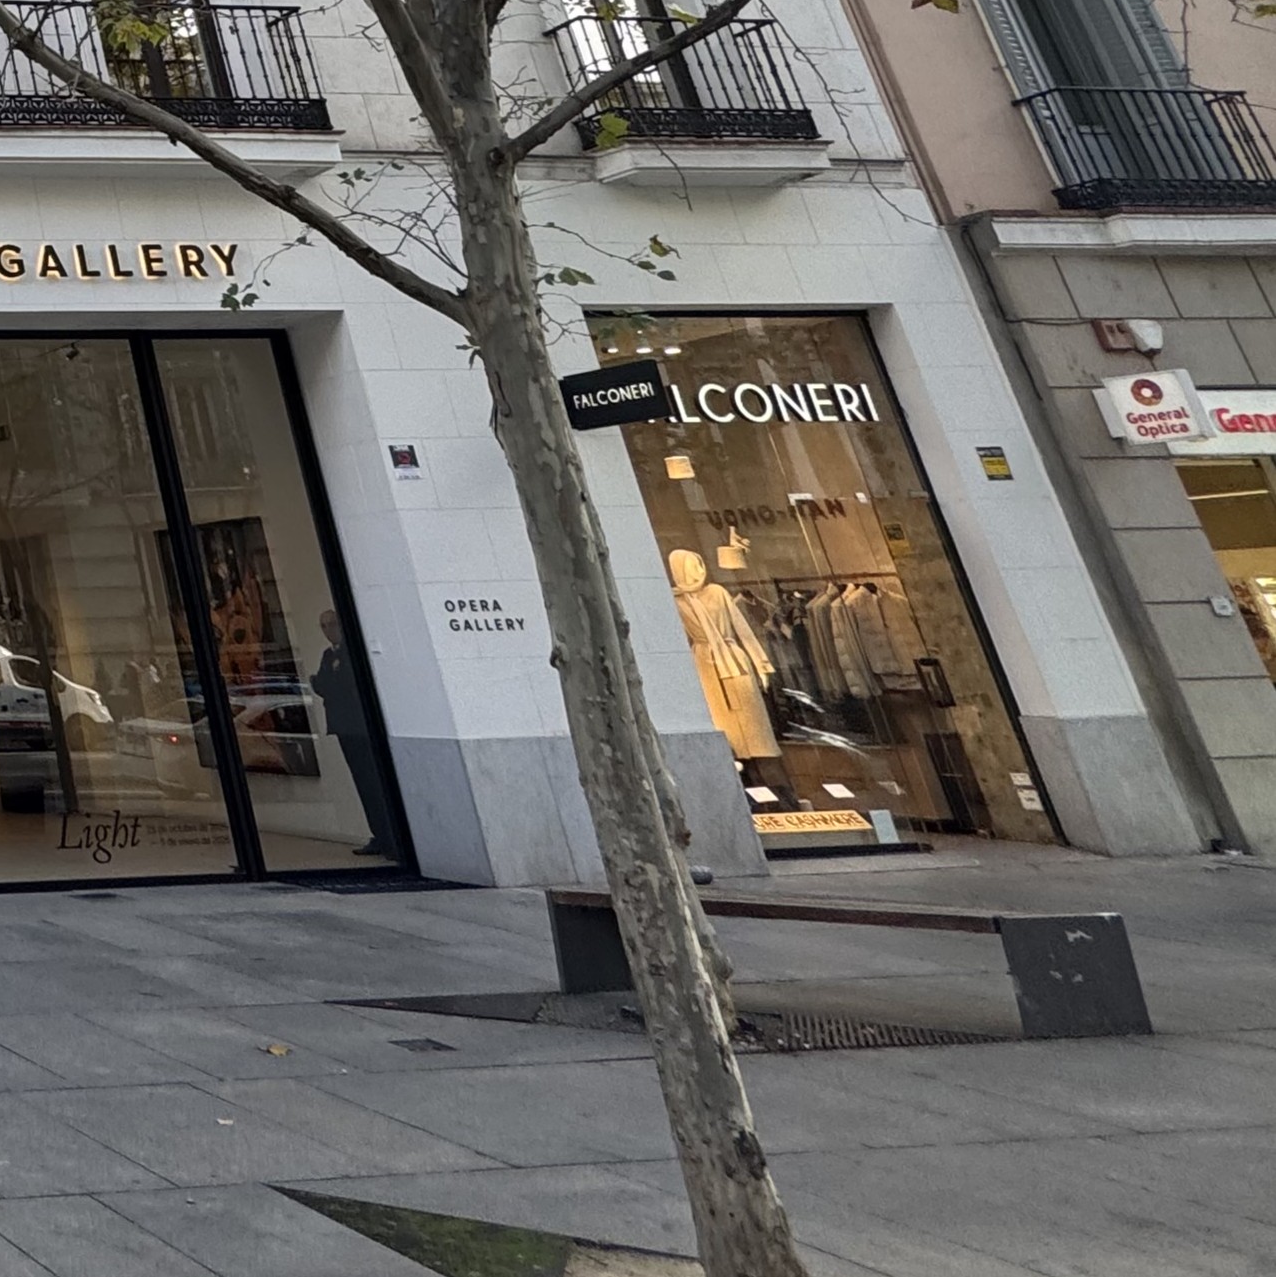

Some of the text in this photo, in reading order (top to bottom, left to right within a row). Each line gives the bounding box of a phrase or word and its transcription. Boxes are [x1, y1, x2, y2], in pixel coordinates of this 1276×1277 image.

[572, 381, 655, 411] FALCONERI
[647, 382, 880, 423] LCONERI
[1126, 406, 1190, 425] General
[1214, 407, 1276, 433] Gen
[1137, 423, 1190, 439] Optica
[444, 599, 502, 613] OPERA
[449, 618, 524, 632] GALLERY
[57, 810, 141, 864] Light
